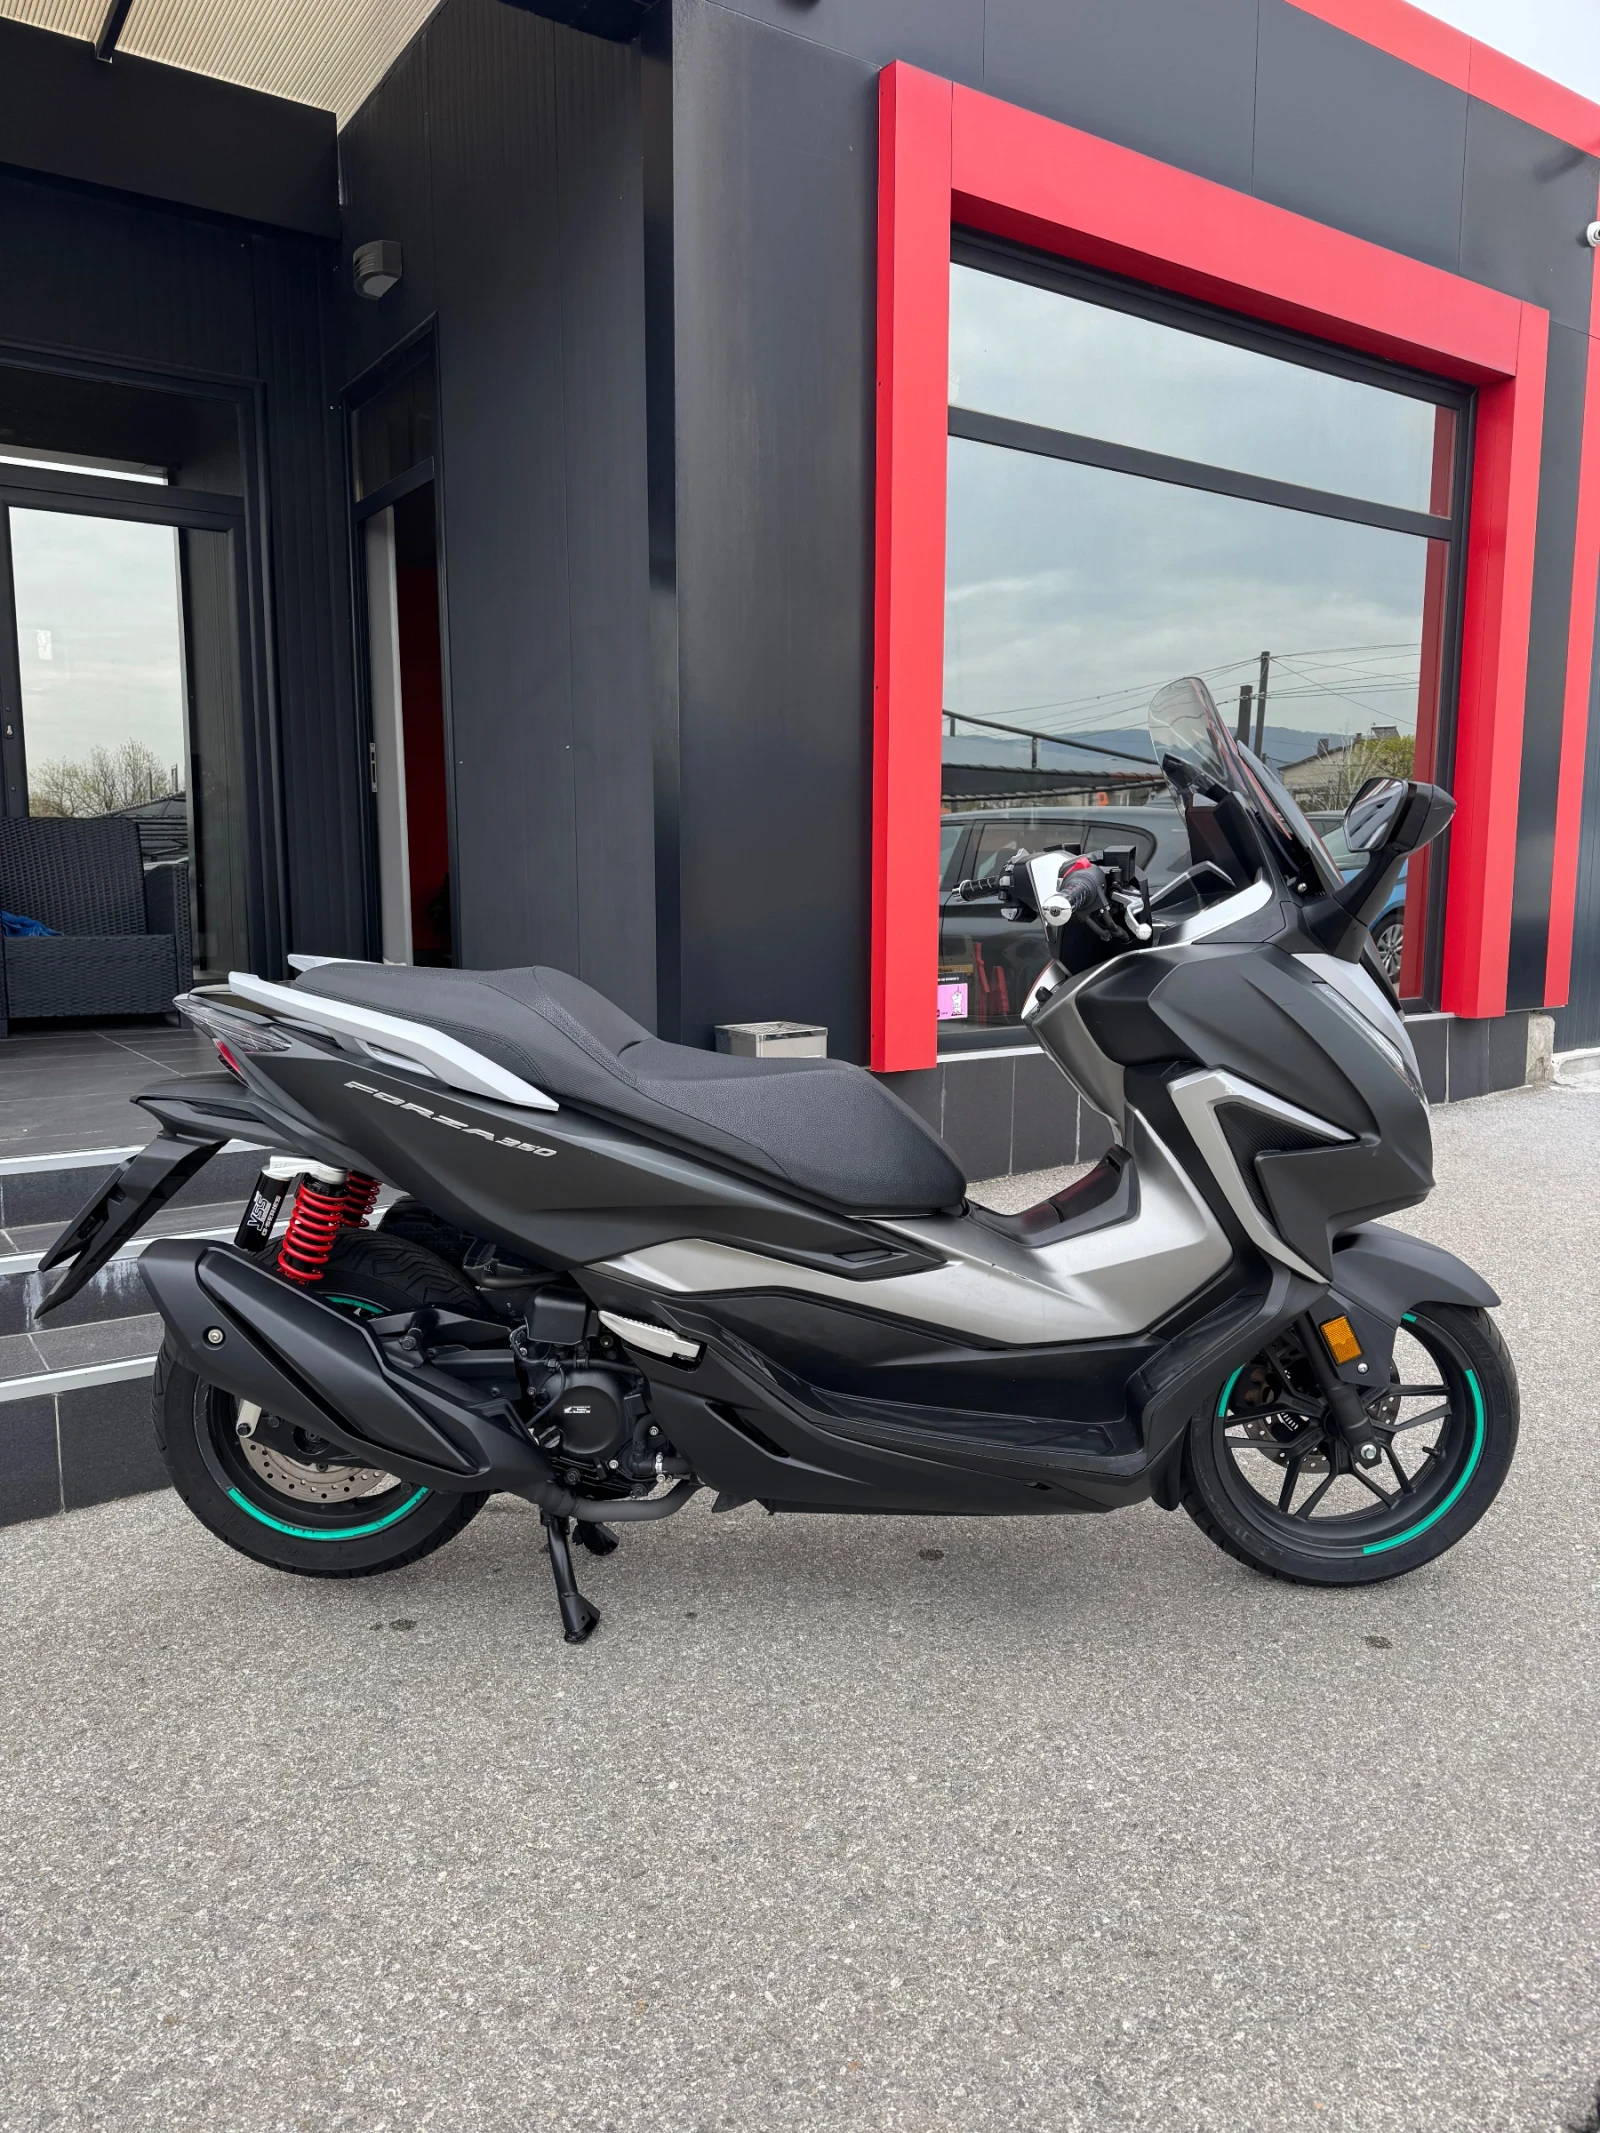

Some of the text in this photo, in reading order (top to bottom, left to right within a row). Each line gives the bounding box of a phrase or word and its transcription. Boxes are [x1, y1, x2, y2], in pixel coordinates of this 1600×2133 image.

[343, 1081, 557, 1157] FORZA 350
[247, 1190, 272, 1231] YSS
